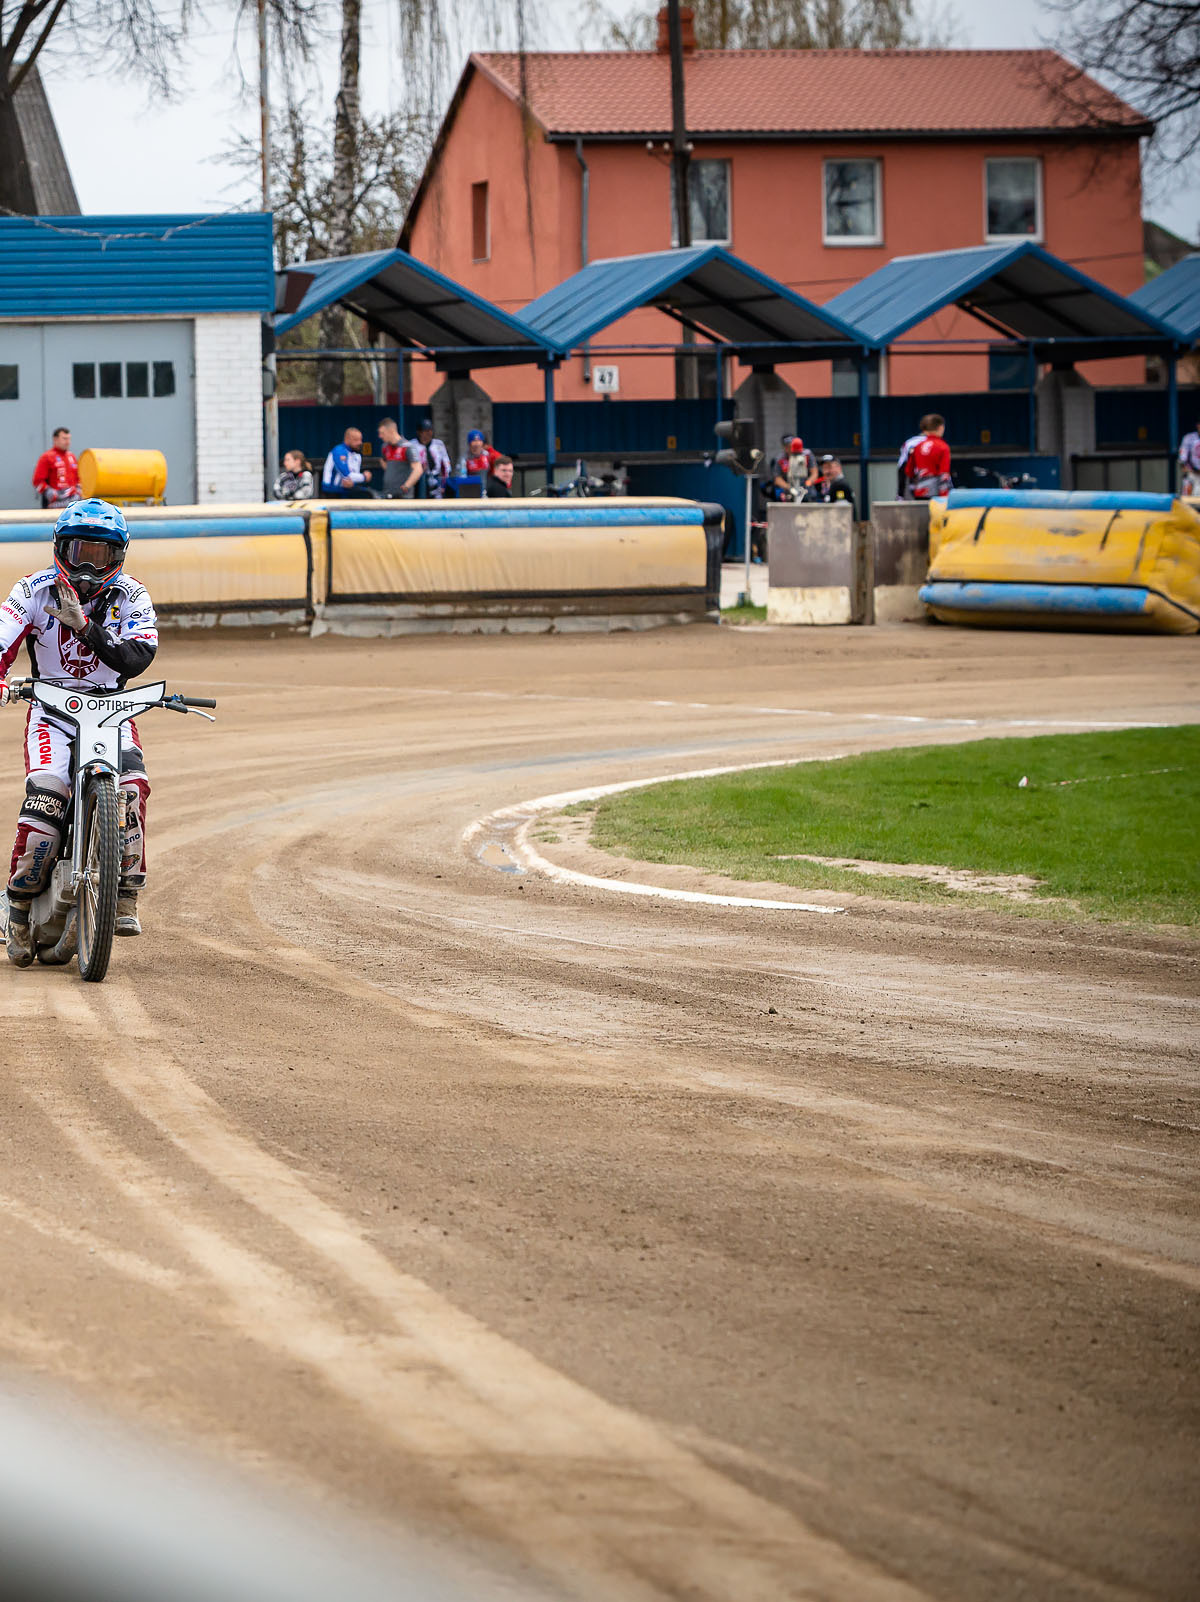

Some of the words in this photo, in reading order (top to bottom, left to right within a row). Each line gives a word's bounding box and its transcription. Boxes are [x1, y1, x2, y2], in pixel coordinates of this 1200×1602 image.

[87, 699, 135, 712] OPTIBET
[36, 794, 63, 809] NIKKEL
[24, 800, 65, 820] CHROM
